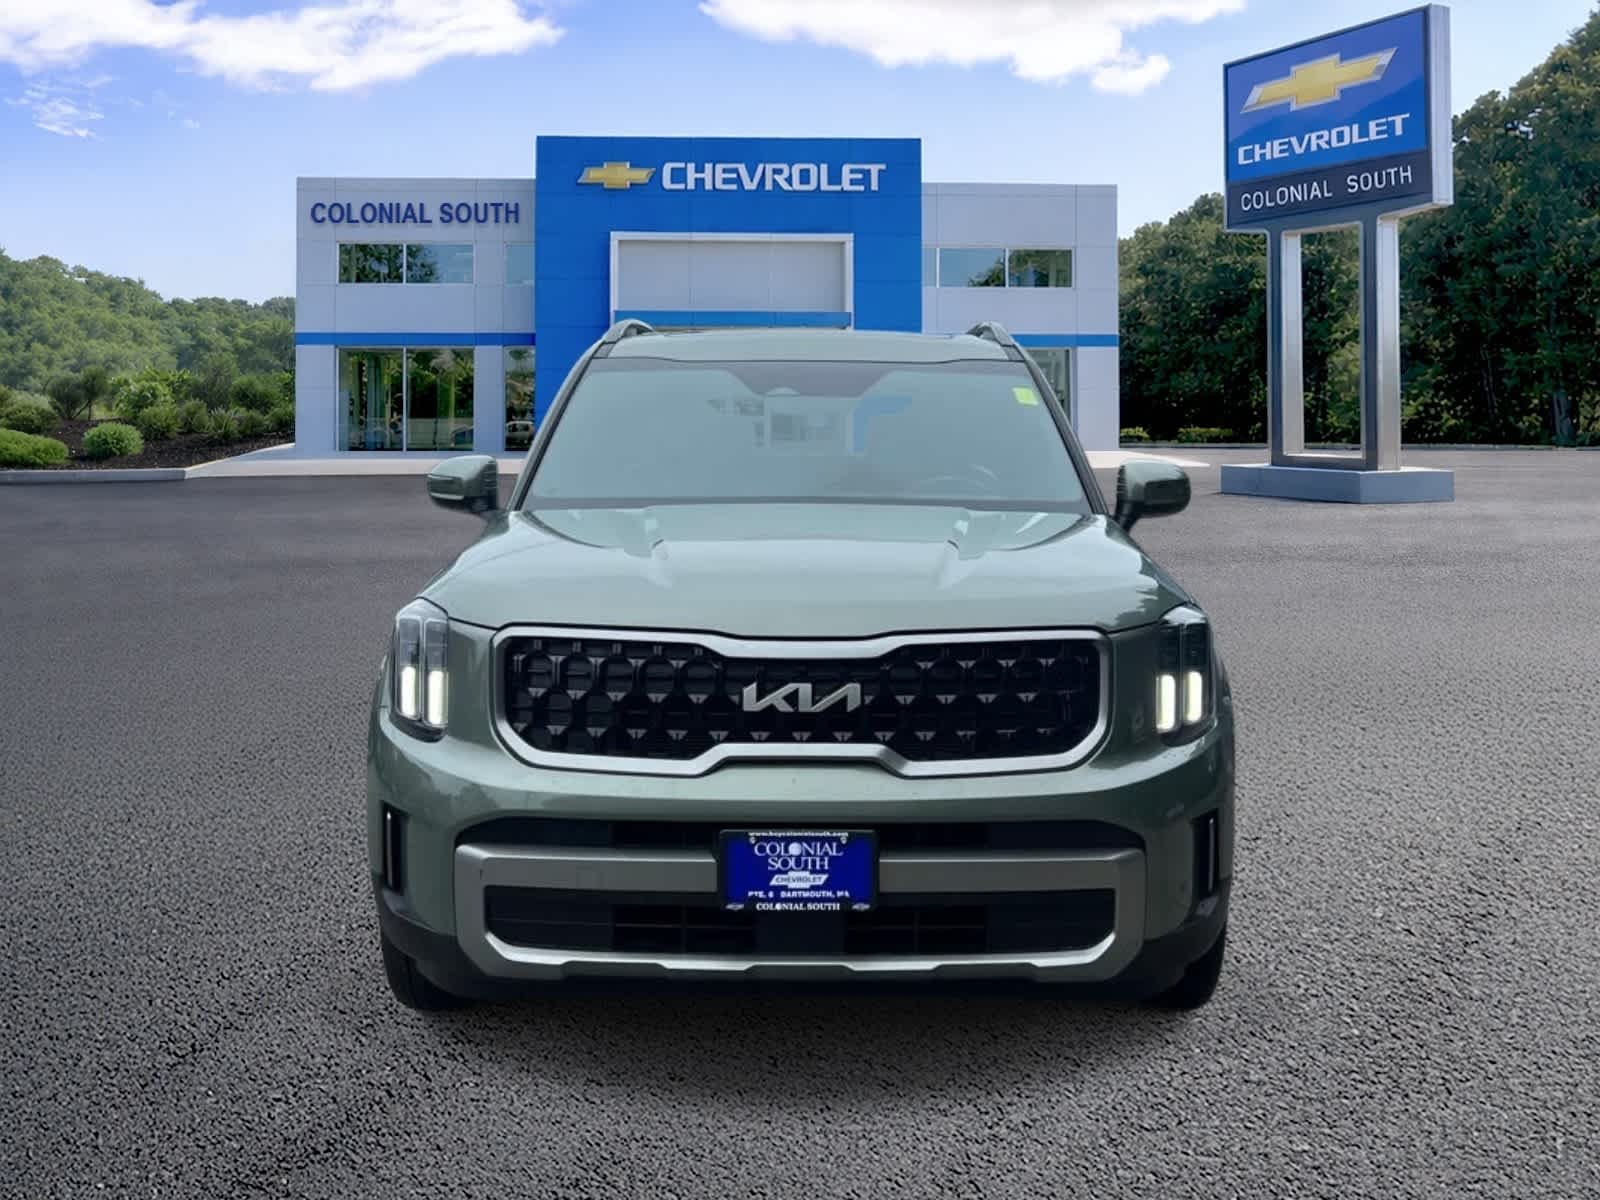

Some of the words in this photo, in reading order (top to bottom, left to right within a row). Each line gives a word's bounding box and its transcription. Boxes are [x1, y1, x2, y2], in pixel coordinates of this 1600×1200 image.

[1237, 113, 1411, 165] CHEVROLET
[662, 162, 887, 191] CHEVROLET
[1240, 180, 1333, 212] COLONIAL
[1346, 165, 1413, 193] SOUTH
[311, 202, 432, 224] COLONIAL
[439, 202, 520, 224] SOUTH
[754, 842, 843, 856] COLONIAL
[767, 857, 830, 871] SOUTH
[775, 875, 823, 883] CHEVROLET
[755, 902, 806, 911] COLONIAL
[807, 902, 841, 911] SOUTH
